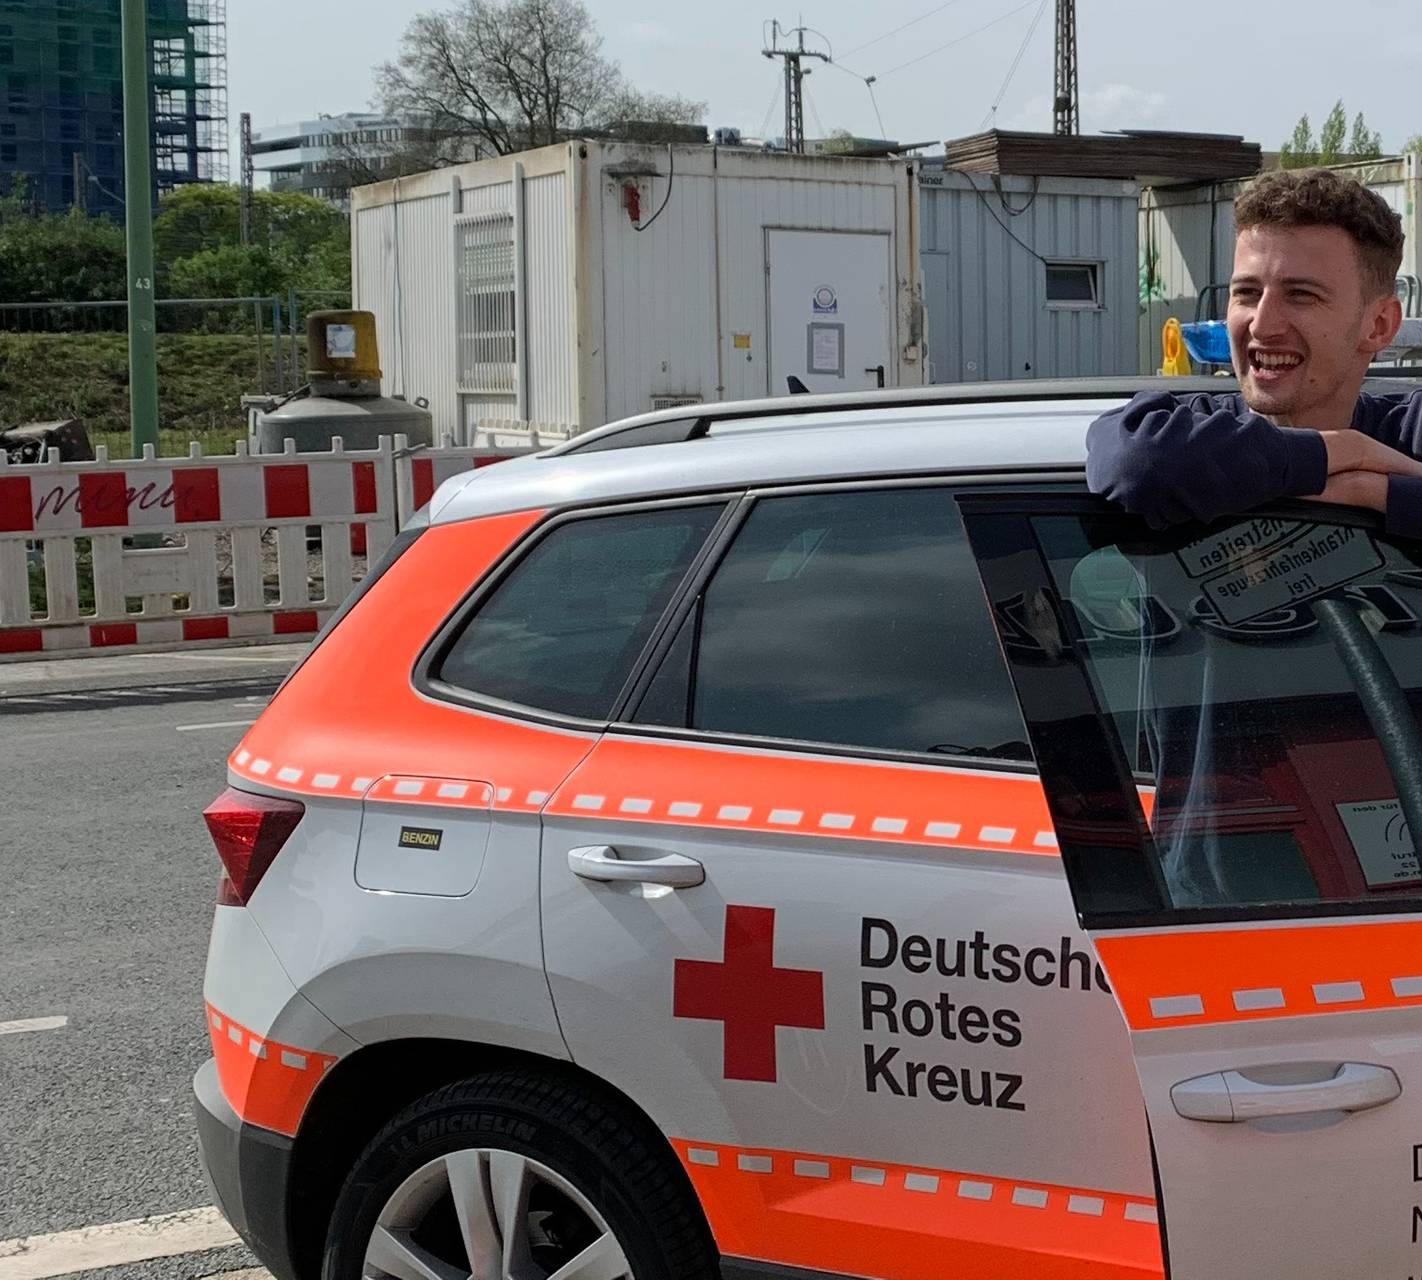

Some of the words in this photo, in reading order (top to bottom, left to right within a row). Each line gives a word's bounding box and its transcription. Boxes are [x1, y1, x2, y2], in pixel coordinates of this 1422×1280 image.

[135, 278, 151, 289] 43
[402, 831, 440, 845] BENZIN
[861, 980, 1023, 1048] Rotes
[863, 1043, 1027, 1112] Kreuz
[416, 1113, 537, 1146] MICHELIN
